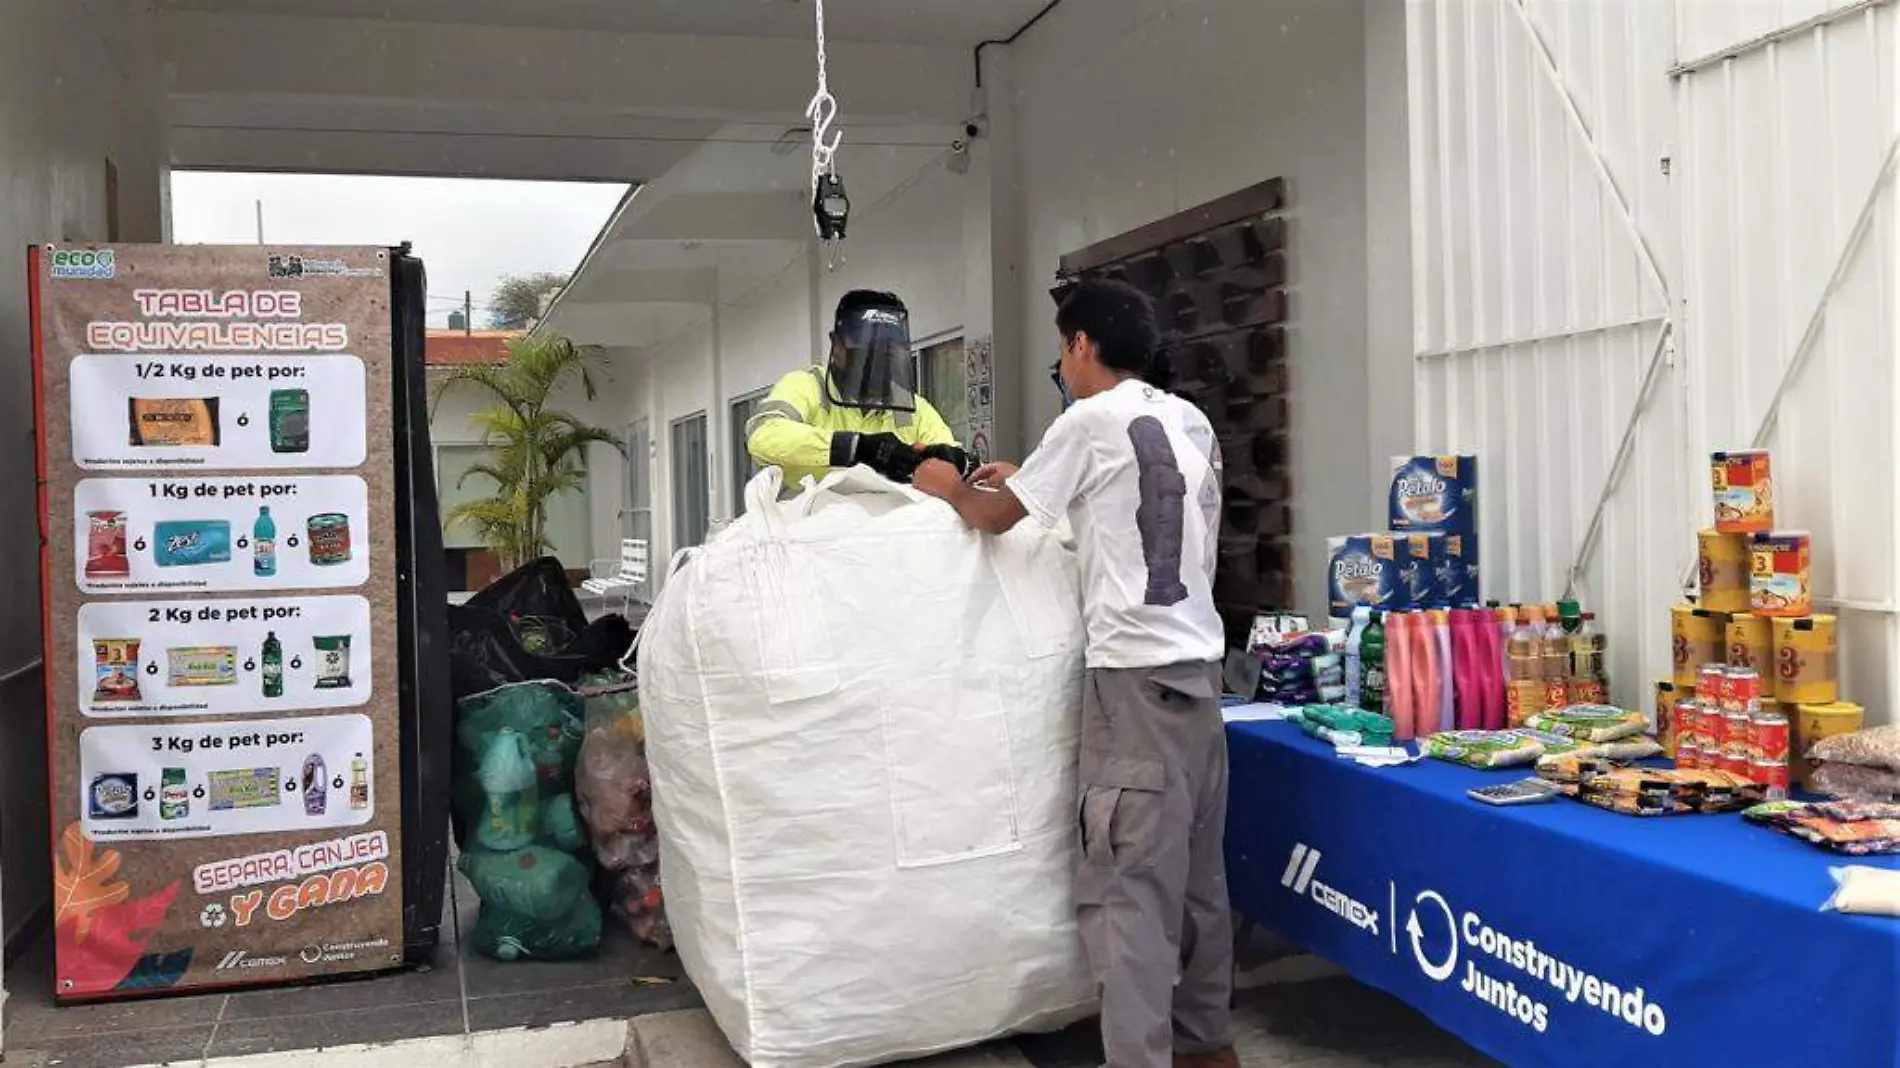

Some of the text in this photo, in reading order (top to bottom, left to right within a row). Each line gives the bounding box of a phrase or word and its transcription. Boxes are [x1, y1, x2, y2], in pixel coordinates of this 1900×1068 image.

[135, 290, 301, 317] TABLA DE
[89, 322, 347, 350] EQUIVALENCIAS
[135, 363, 305, 381] 1/2 Kg de pet por:
[236, 412, 249, 427] ó
[149, 482, 297, 500] 1 Kg de pet por:
[134, 534, 147, 551] ó
[237, 533, 248, 549] ó
[287, 532, 299, 547] ó
[148, 605, 301, 624] 2 Kg de pet por:
[146, 659, 158, 675] ó
[244, 656, 256, 671] ó
[290, 653, 302, 669] ó
[152, 731, 304, 753] 3 Kg de pet por:
[144, 774, 344, 801] ó ó ó ó
[298, 834, 386, 871] CANJEA
[230, 861, 388, 927] Y GANA
[1311, 879, 1380, 936] CEMEX
[1462, 911, 1666, 1037] Construyendo
[1460, 961, 1550, 1034] Juntos
